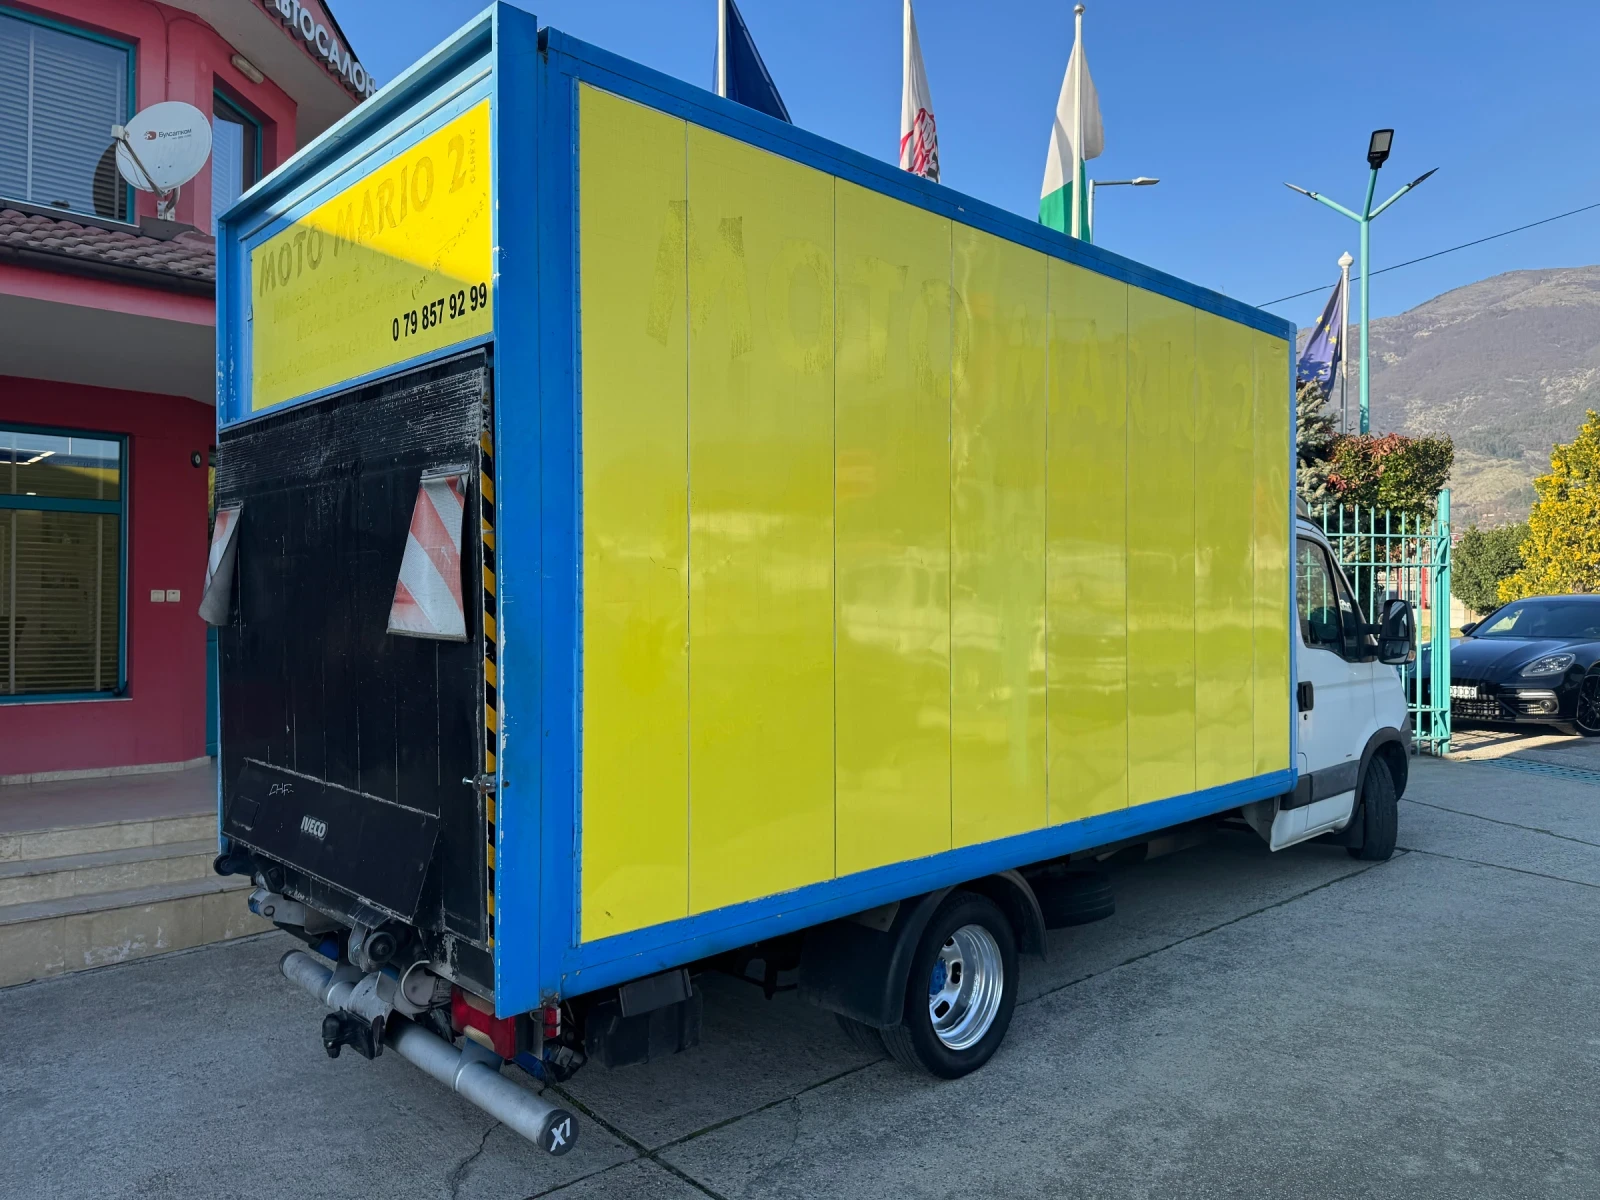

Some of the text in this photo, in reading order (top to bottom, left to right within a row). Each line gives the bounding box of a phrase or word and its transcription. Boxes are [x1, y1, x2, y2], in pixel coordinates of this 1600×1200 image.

[274, 0, 376, 99] ВТОСАЛОН
[259, 222, 325, 298] MOTO
[333, 155, 435, 257] MARIO
[447, 133, 469, 195] 2
[392, 317, 400, 342] 0
[403, 309, 418, 338] 79
[421, 297, 445, 331] 857
[448, 289, 466, 320] 92
[469, 281, 488, 312] 99
[300, 815, 326, 838] IVECO
